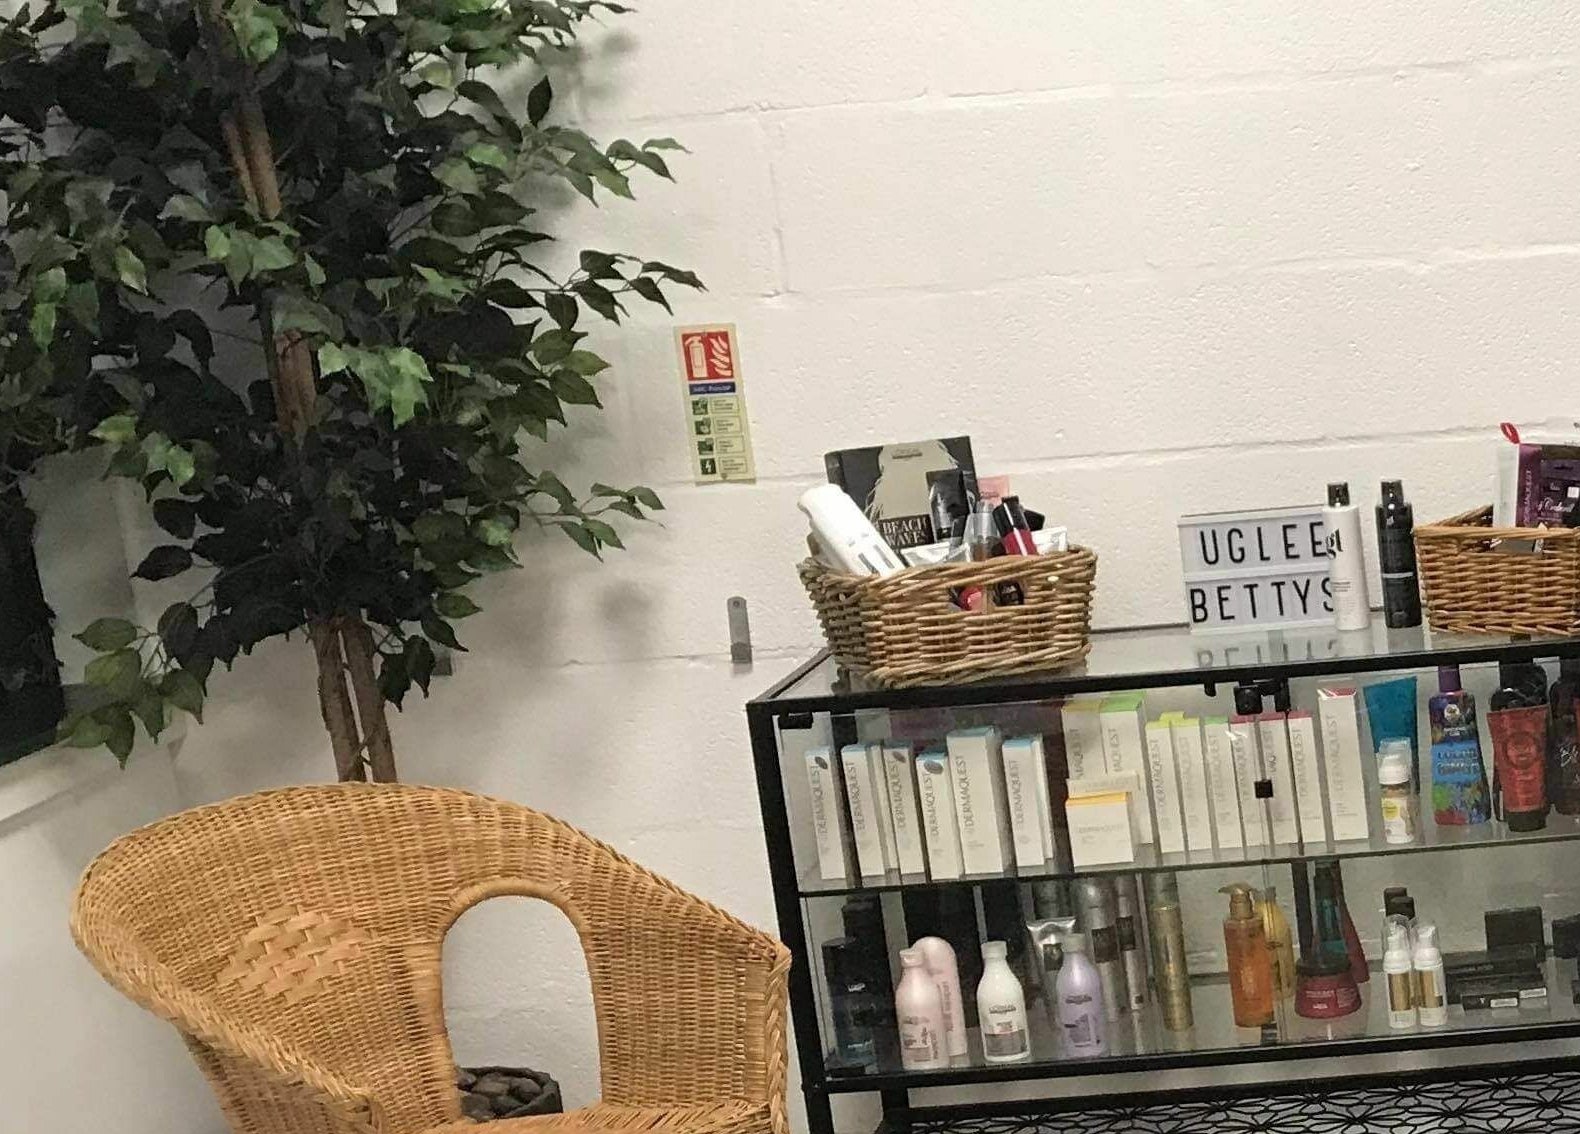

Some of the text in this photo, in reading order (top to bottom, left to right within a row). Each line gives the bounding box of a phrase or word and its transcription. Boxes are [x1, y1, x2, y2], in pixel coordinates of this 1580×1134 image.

[882, 517, 928, 535] BEACH
[885, 530, 927, 547] WAVES
[1199, 521, 1327, 565] UGLEE
[1189, 577, 1334, 623] BETTYS
[845, 760, 866, 830] DERMAQUEST
[887, 759, 906, 828] DERMAQUEST
[922, 772, 940, 836] DERMAQUEST
[955, 755, 974, 827] DERMAQUEST
[1009, 760, 1024, 824] DERMAQUEST
[1149, 739, 1167, 807] DERMAQUEST
